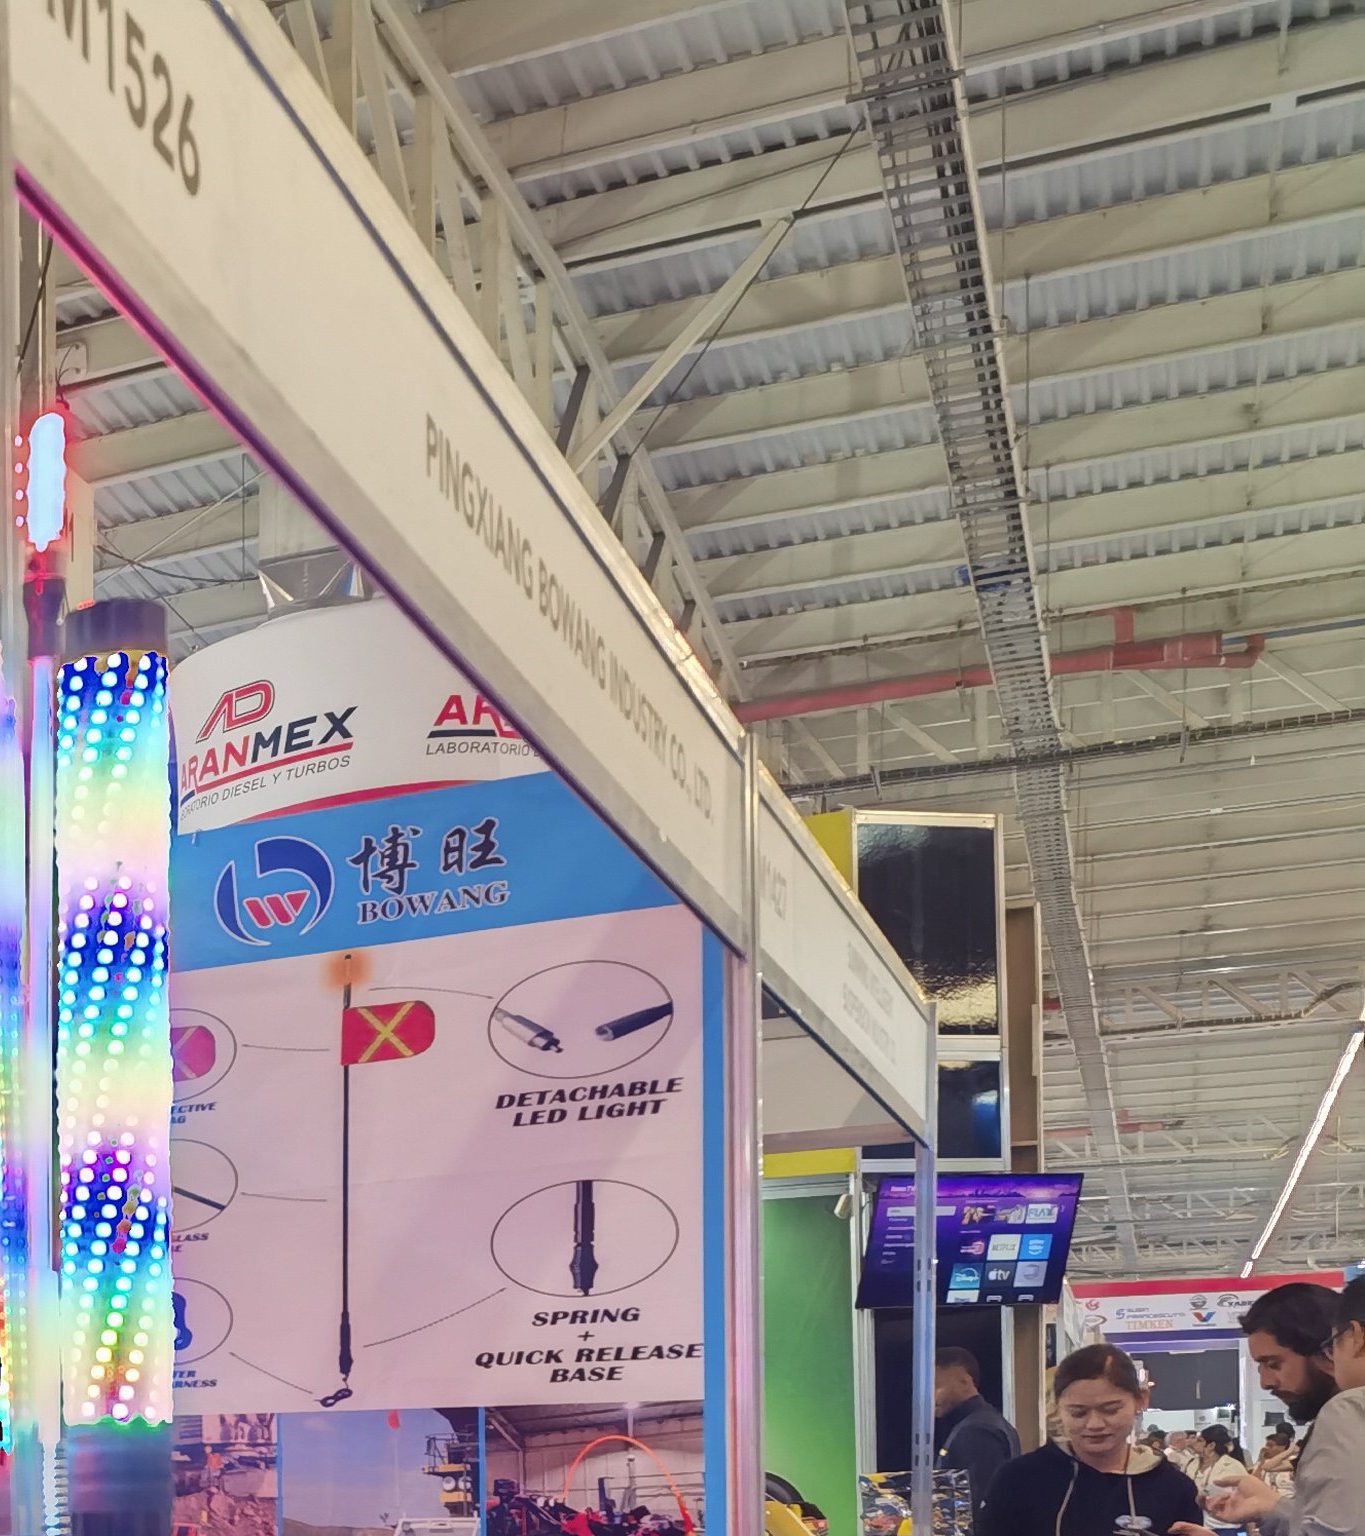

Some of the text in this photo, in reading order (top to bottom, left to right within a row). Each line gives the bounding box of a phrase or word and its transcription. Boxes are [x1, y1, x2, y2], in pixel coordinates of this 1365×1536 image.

[425, 411, 536, 601] PINGXIANG
[537, 565, 608, 692] BOWANG
[608, 647, 669, 770] INDUSTRY
[693, 773, 716, 825] LTD.
[180, 705, 359, 793] ARANMEX
[425, 742, 531, 757] LABORATORIO
[221, 776, 267, 802] DIESEL
[272, 772, 282, 785] Y
[286, 755, 351, 782] TURBOS
[347, 815, 508, 899] 博旺
[356, 879, 510, 926] BOWANG
[495, 1076, 684, 1111] DETACHABLE
[511, 1100, 667, 1128] LED LIGHT
[531, 1305, 641, 1327] SPRING
[1126, 1319, 1173, 1330] TIMKEN
[474, 1343, 703, 1369] QUICK RELEASE
[549, 1364, 624, 1385] BASE
